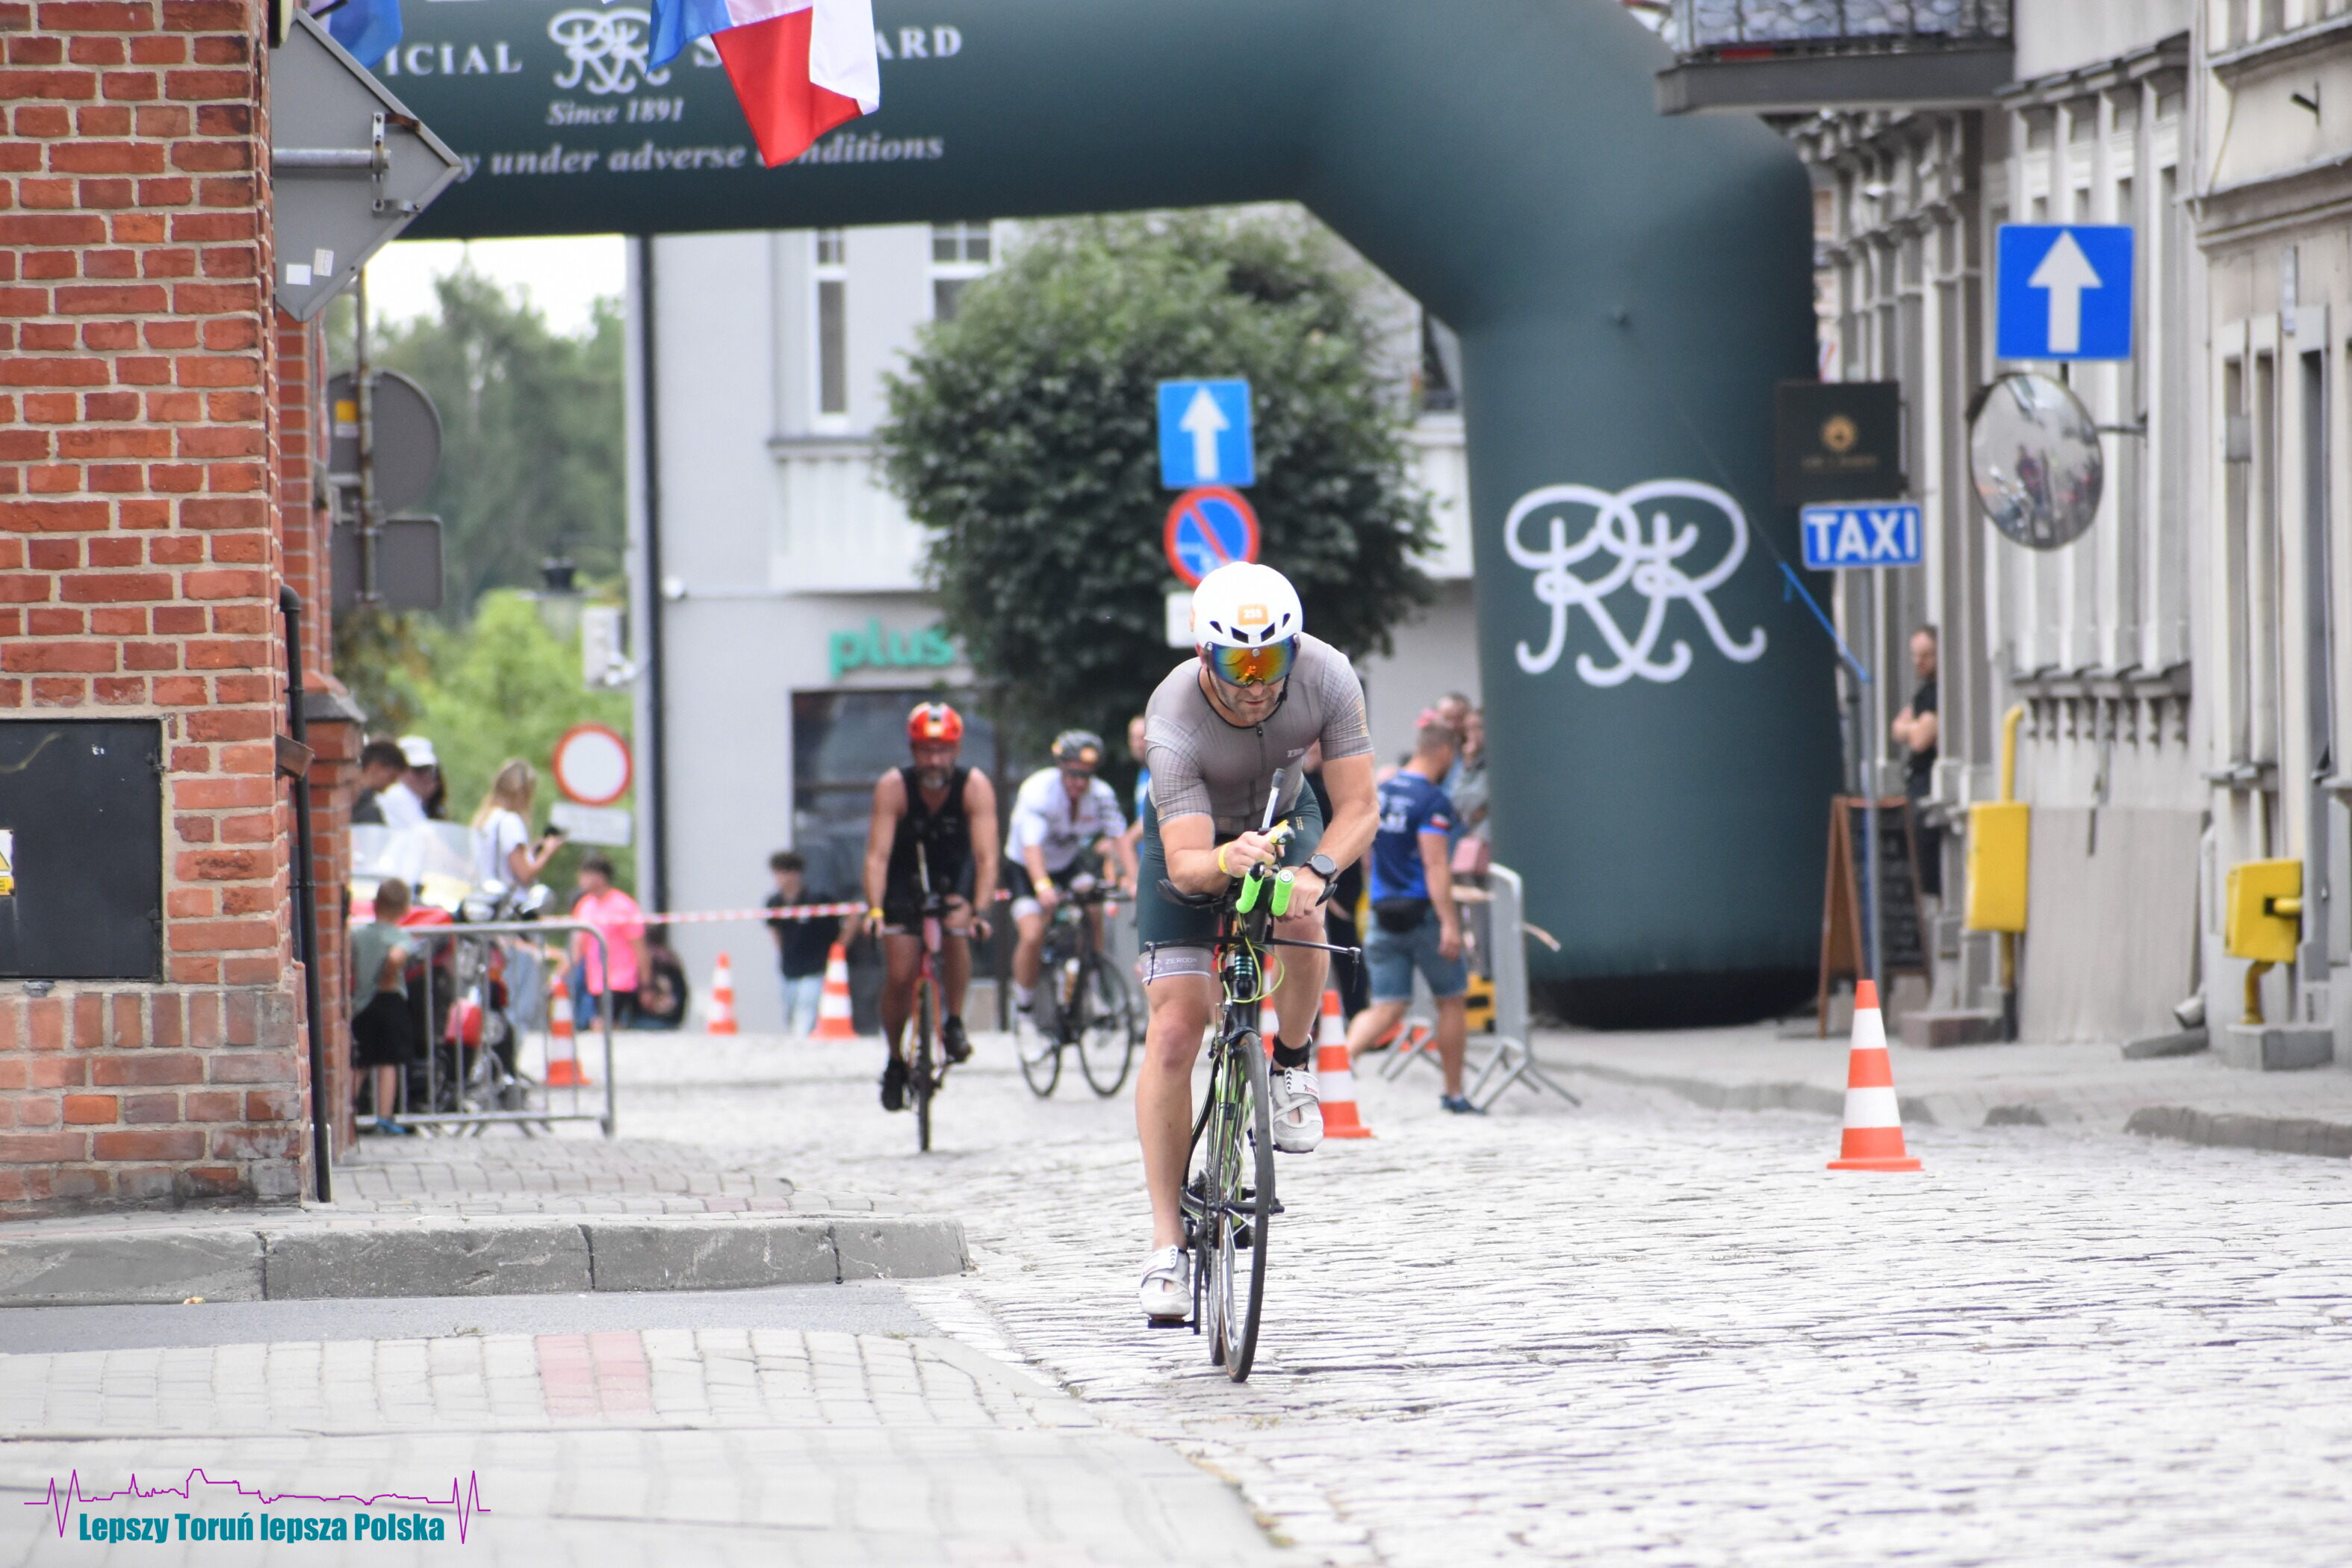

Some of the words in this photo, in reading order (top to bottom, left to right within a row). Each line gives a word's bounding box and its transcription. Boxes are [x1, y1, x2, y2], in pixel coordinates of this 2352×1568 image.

[385, 41, 524, 76] ICIAL
[546, 99, 619, 125] Since
[626, 97, 684, 123] 1891
[490, 142, 600, 175] under
[607, 140, 747, 172] adverse
[756, 131, 944, 167] nditions
[1806, 510, 1918, 561] TAXI
[829, 617, 955, 681] plus
